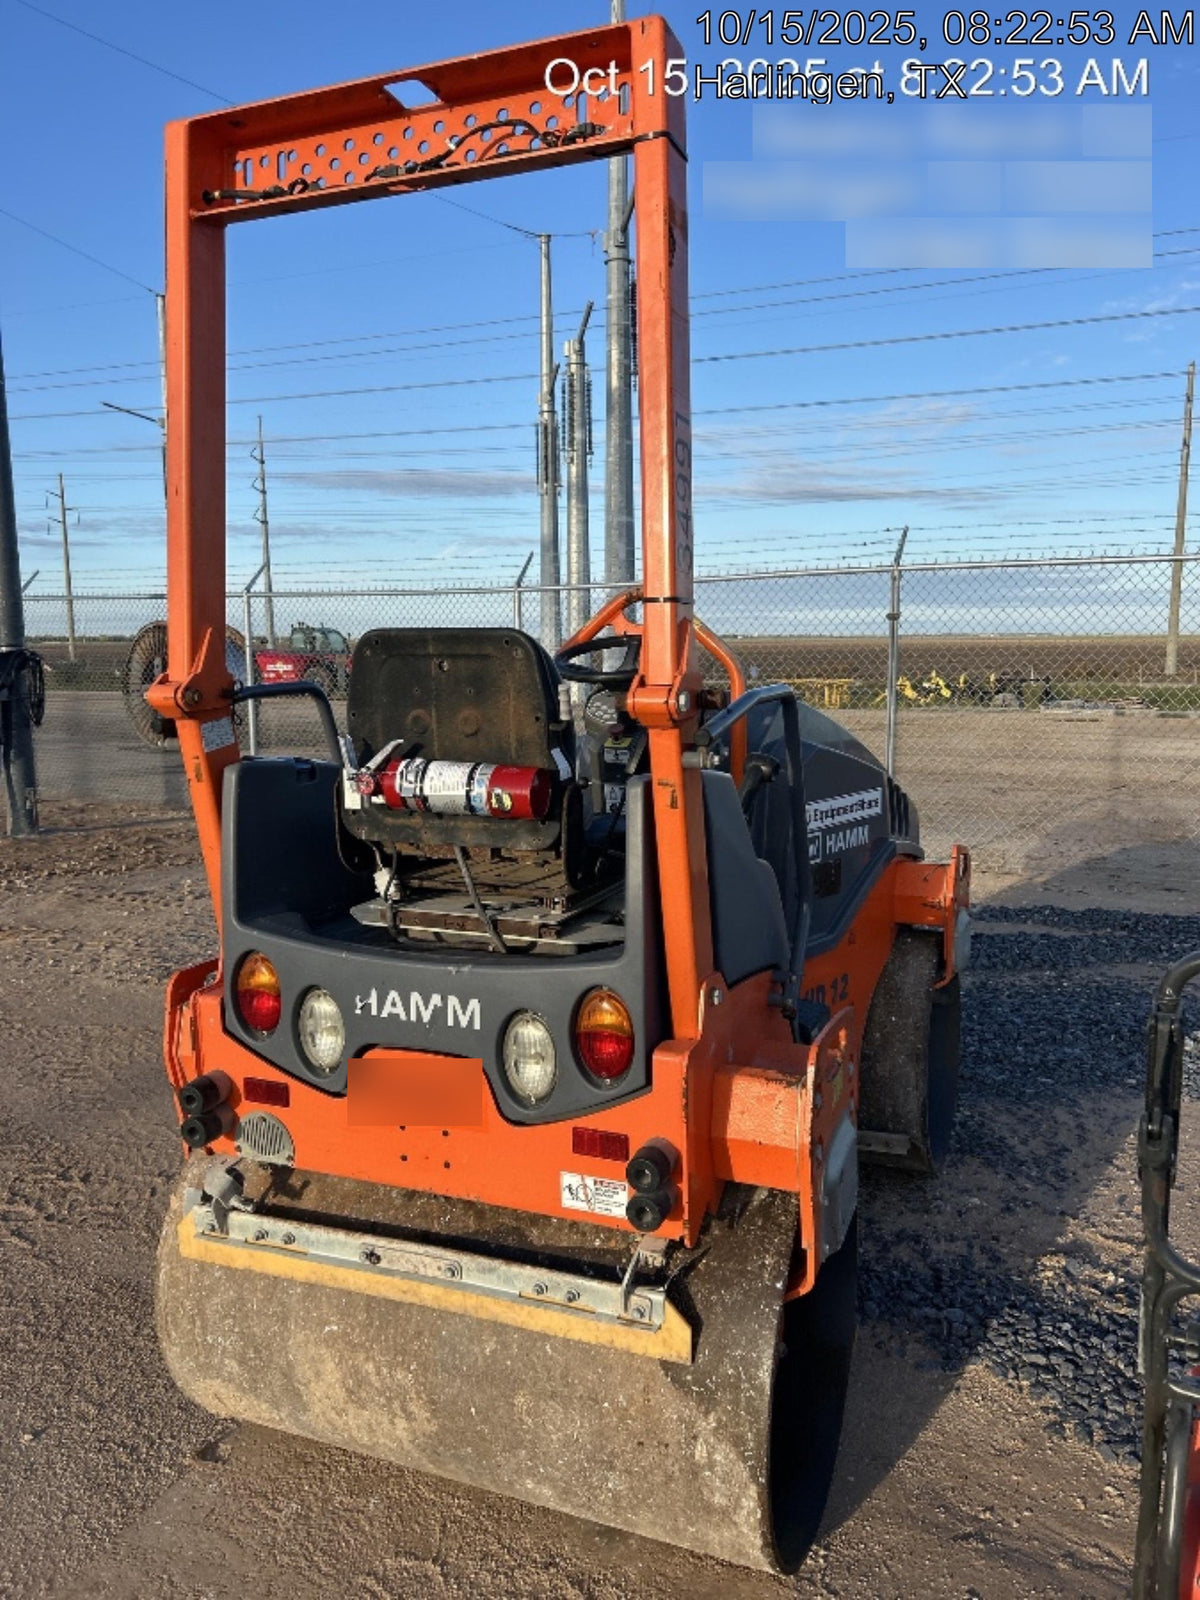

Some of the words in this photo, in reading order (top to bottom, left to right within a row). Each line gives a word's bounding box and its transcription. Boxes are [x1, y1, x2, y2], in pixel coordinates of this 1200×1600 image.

[826, 825, 869, 855] HAMM
[830, 973, 849, 1004] 12
[355, 987, 480, 1030] HAMM
